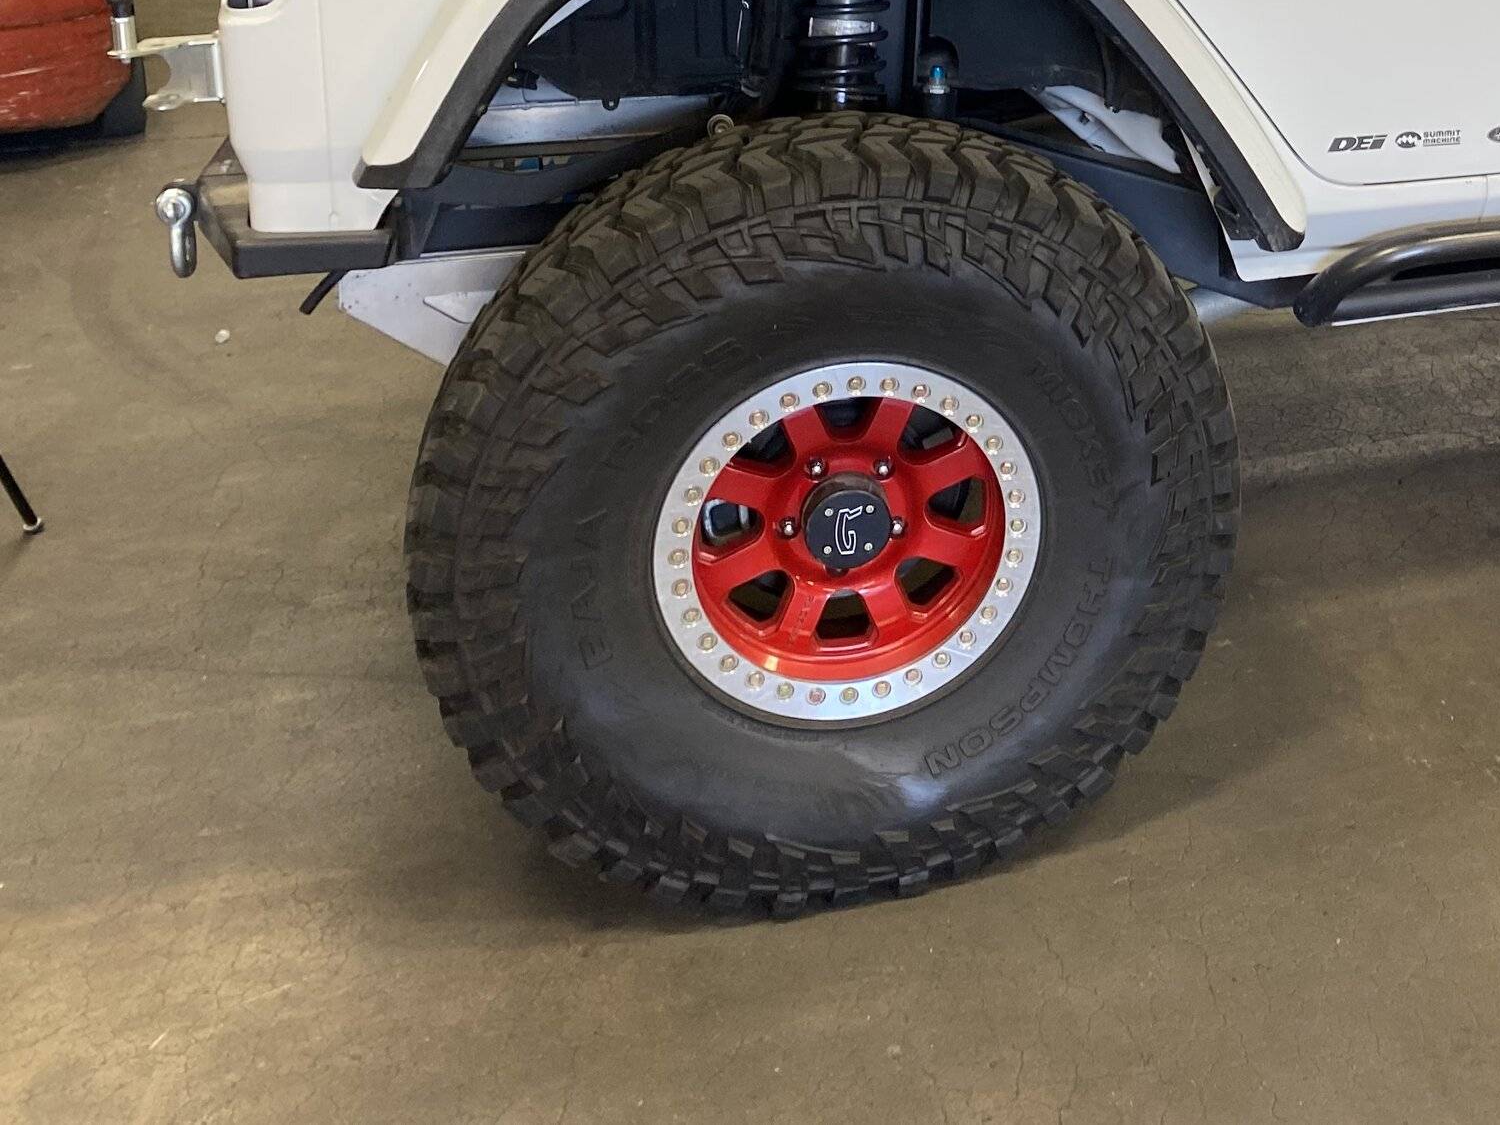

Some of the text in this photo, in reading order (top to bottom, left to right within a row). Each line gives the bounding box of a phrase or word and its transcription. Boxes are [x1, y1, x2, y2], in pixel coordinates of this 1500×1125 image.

[1423, 129, 1462, 138] SUMMIT
[1423, 137, 1461, 145] MACHINE
[927, 557, 1116, 777] THOMPSON
